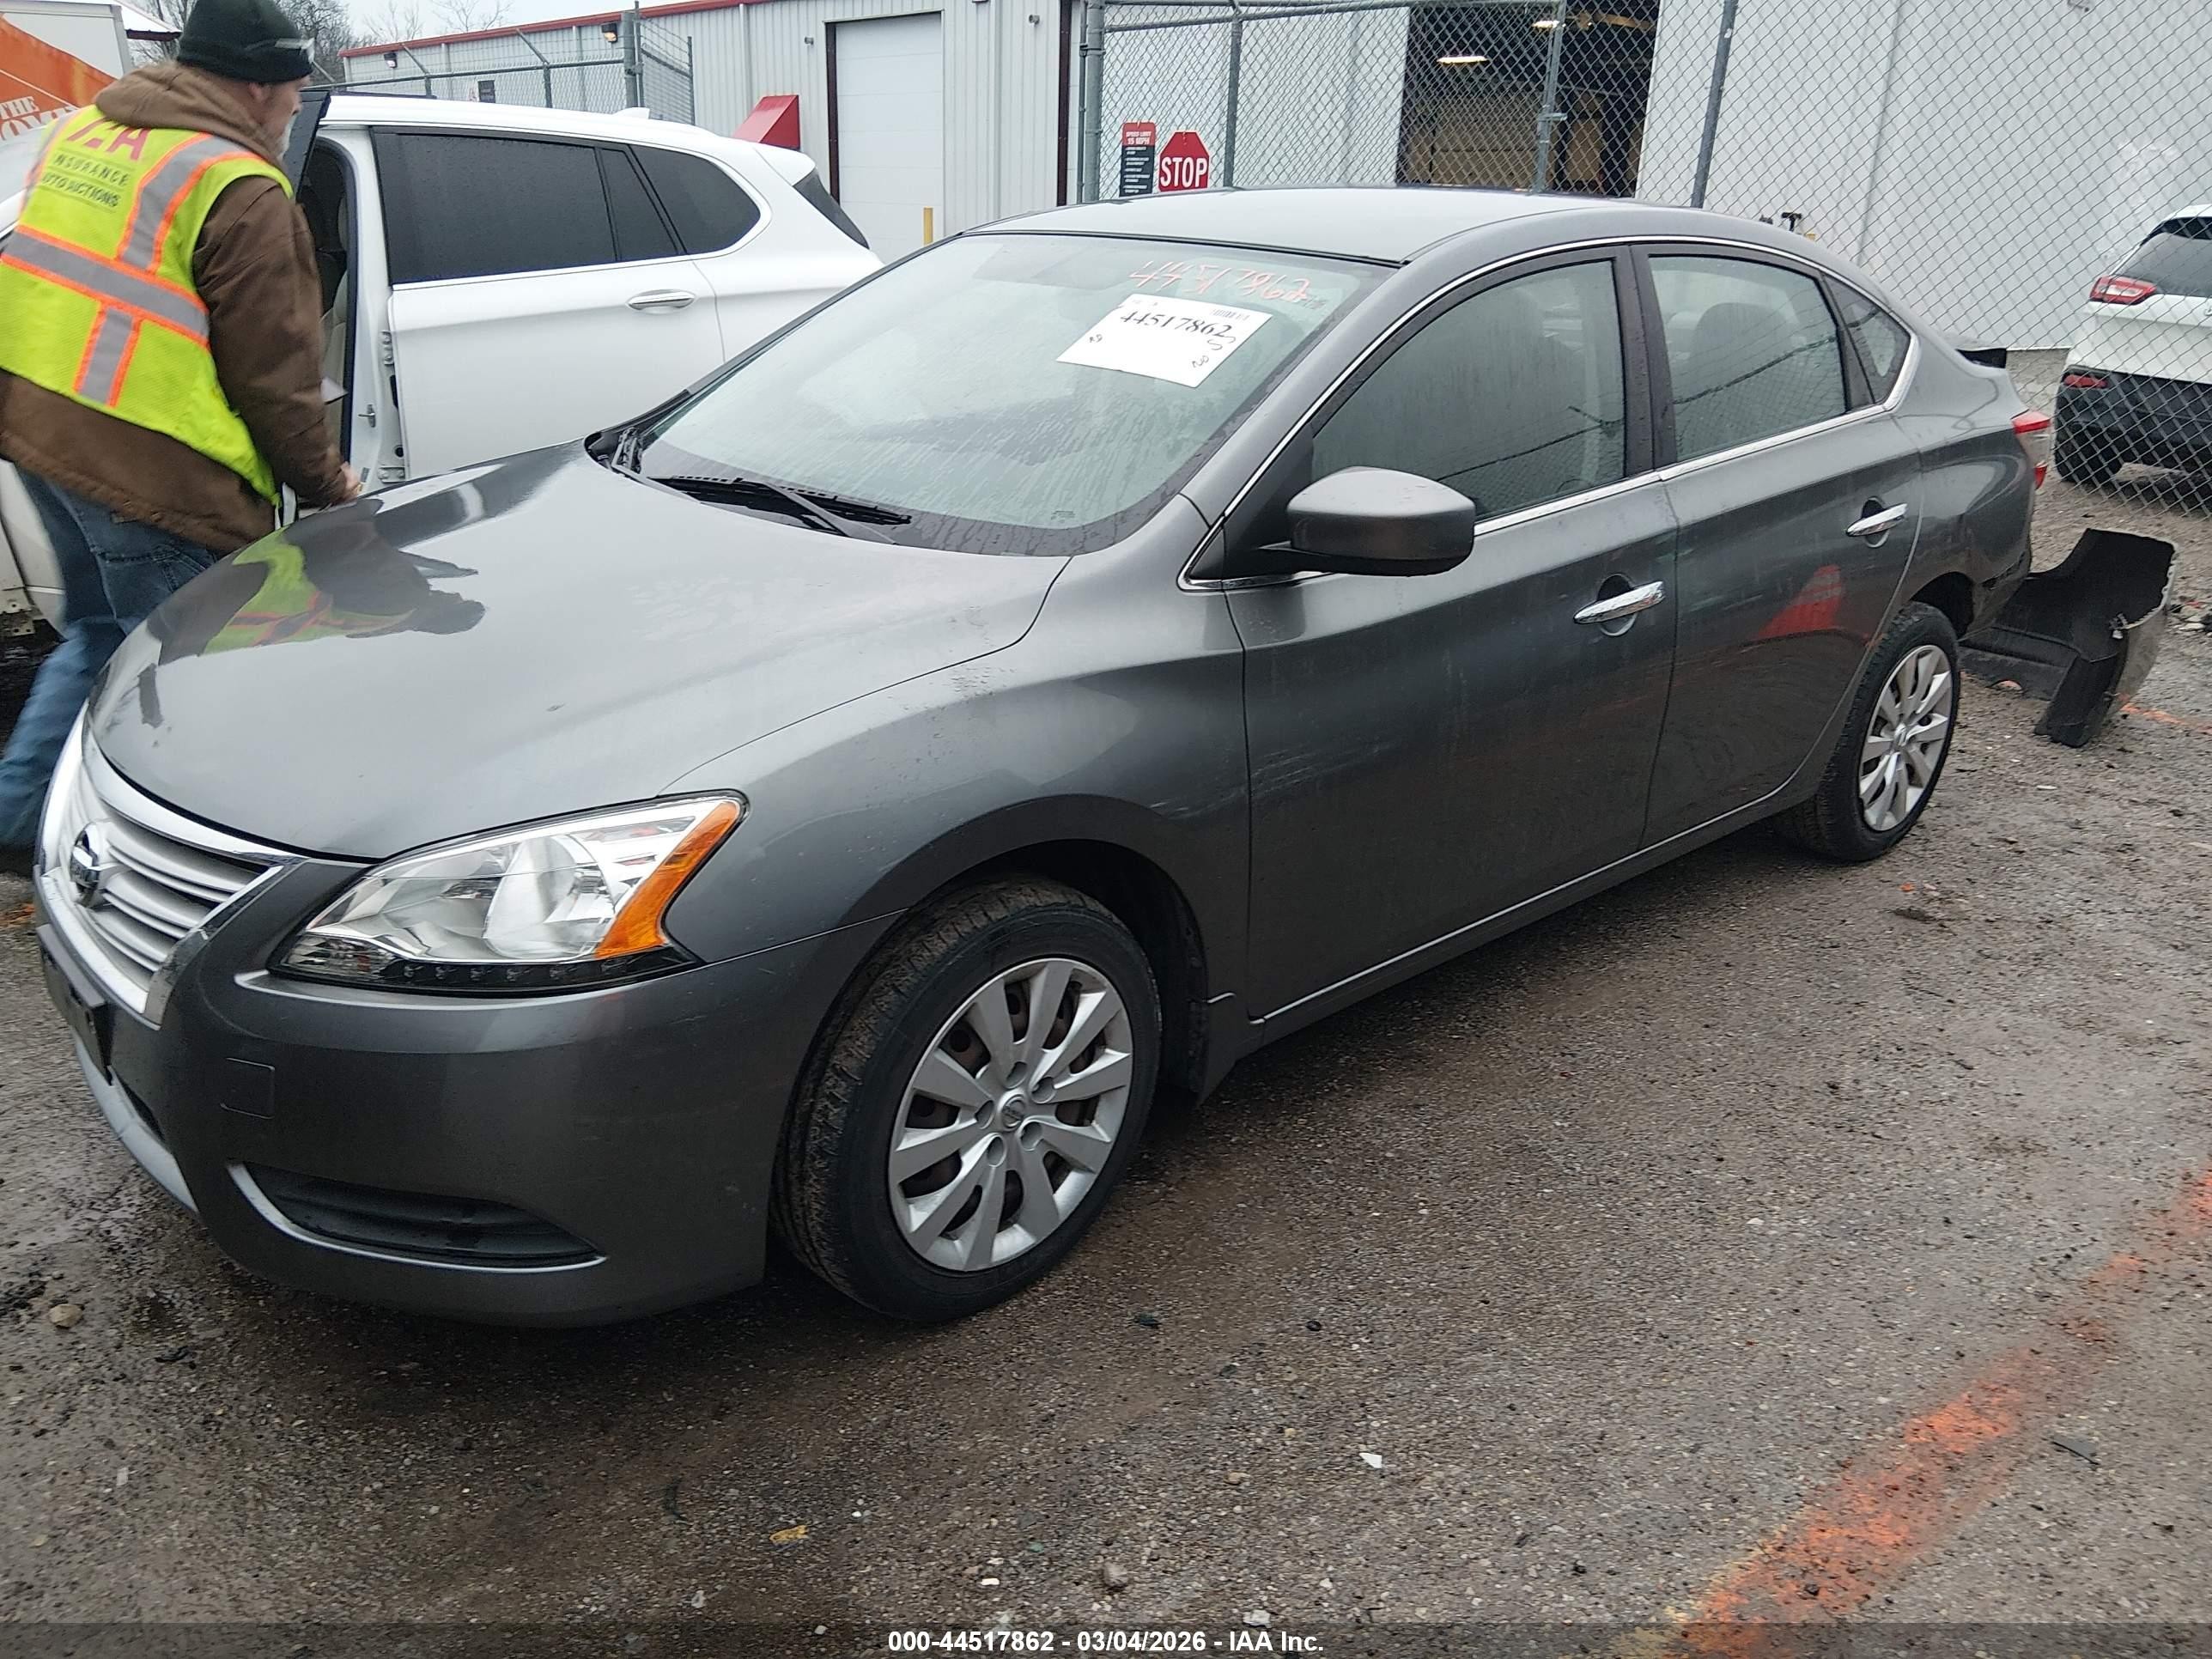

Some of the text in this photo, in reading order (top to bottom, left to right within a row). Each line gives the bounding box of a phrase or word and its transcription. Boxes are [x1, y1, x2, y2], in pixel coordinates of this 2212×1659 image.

[42, 172, 69, 190] UTO
[53, 154, 131, 187] NSURANCE
[1160, 156, 1208, 188] STOP
[1120, 310, 1233, 337] 44517862
